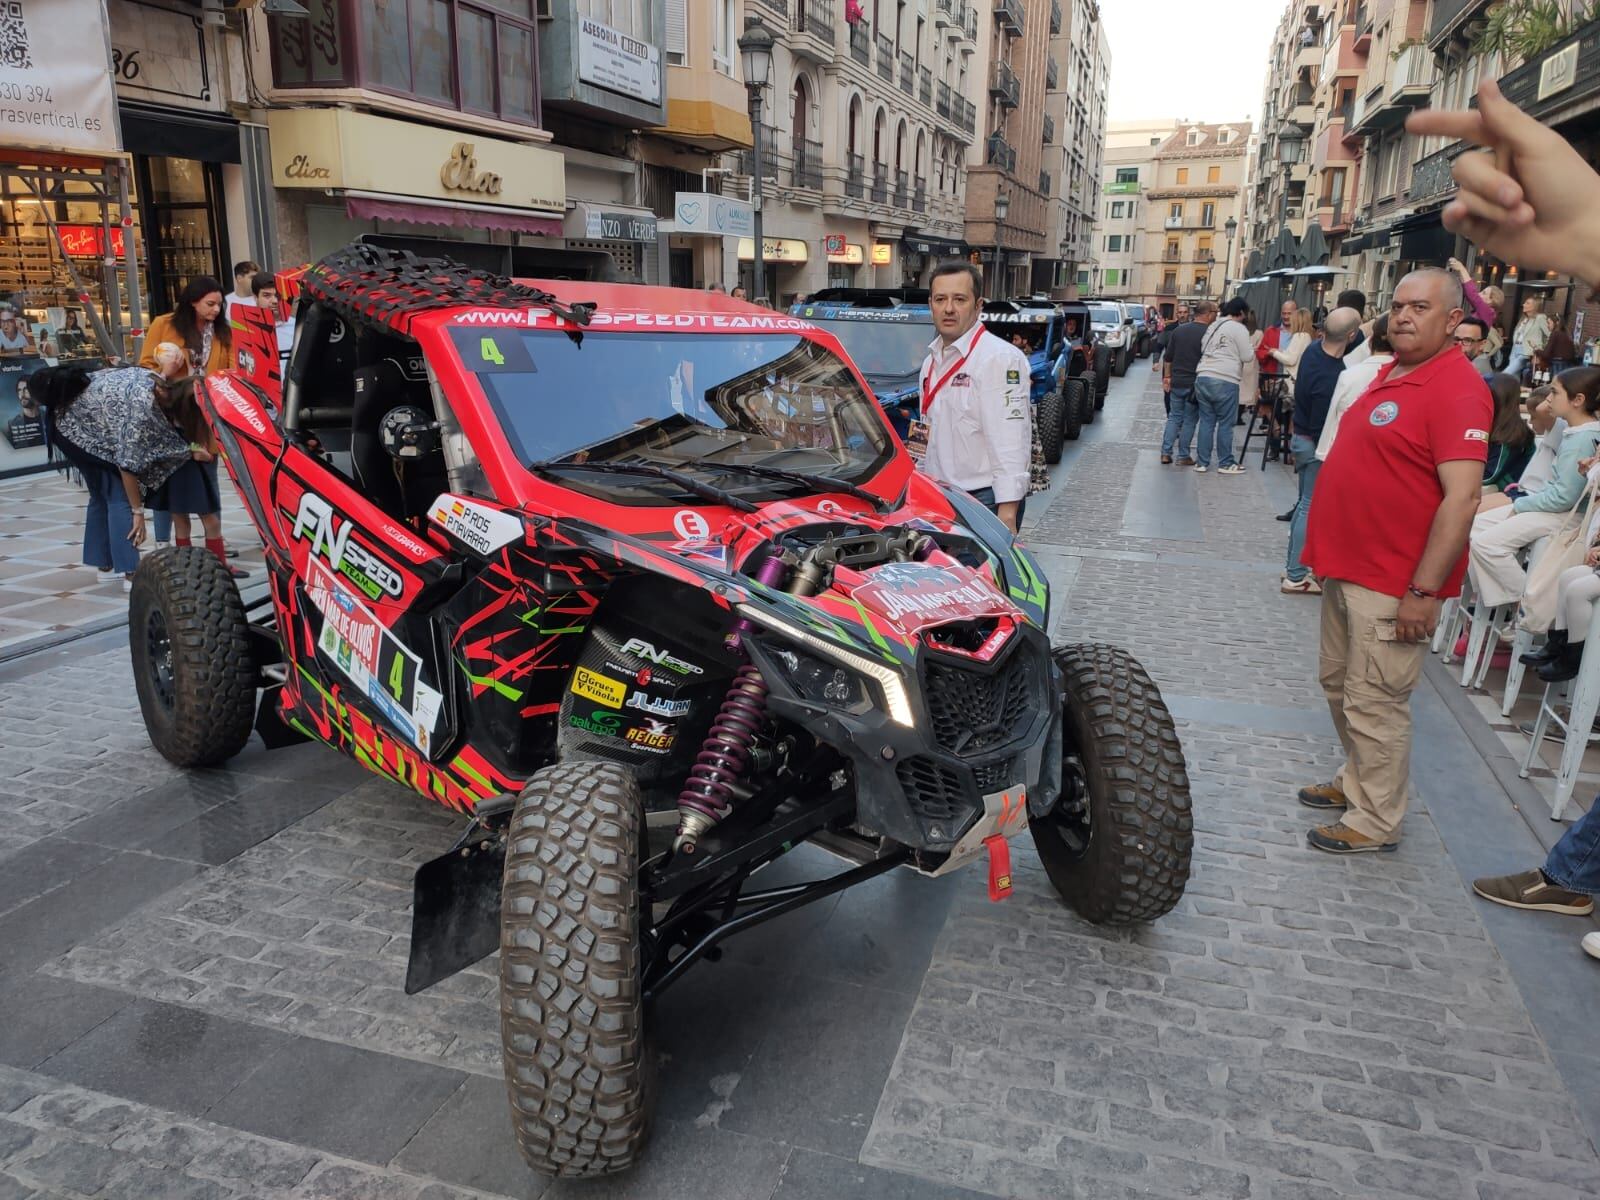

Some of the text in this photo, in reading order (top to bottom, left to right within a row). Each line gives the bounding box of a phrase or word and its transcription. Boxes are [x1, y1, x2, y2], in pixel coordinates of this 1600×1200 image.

[583, 20, 618, 46] ASESORIA
[0, 82, 52, 103] 30 394
[629, 220, 656, 240] VERDE
[805, 308, 814, 317] 5
[481, 338, 504, 364] 4
[681, 514, 701, 535] E
[343, 564, 370, 587] TEAM
[344, 541, 403, 596] SPEED
[388, 650, 404, 701] 4
[588, 678, 615, 693] Grues
[625, 727, 674, 748] REIGER
